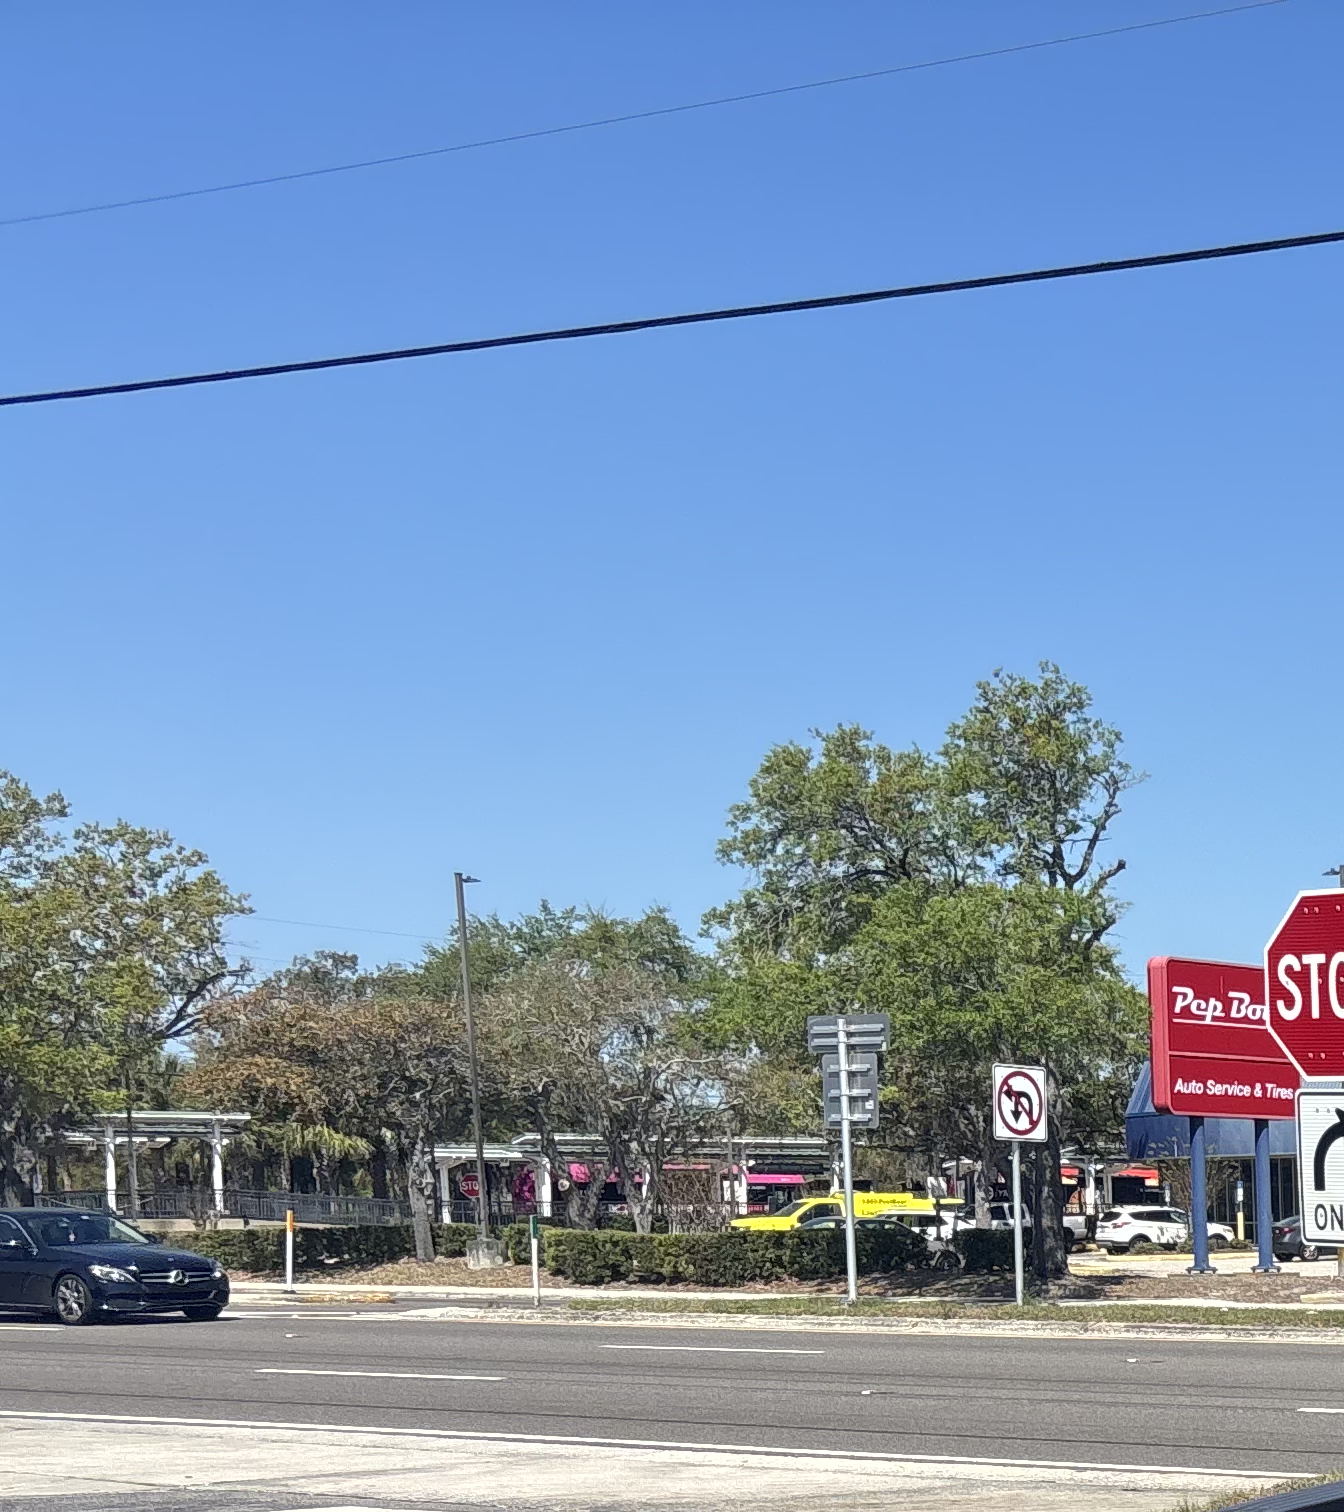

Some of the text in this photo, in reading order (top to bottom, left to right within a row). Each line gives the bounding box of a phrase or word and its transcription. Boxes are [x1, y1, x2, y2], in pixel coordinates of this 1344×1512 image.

[1172, 986, 1268, 1022] Pep Bo
[1174, 1078, 1294, 1100] Auto Service & Tires
[461, 1181, 479, 1191] STO
